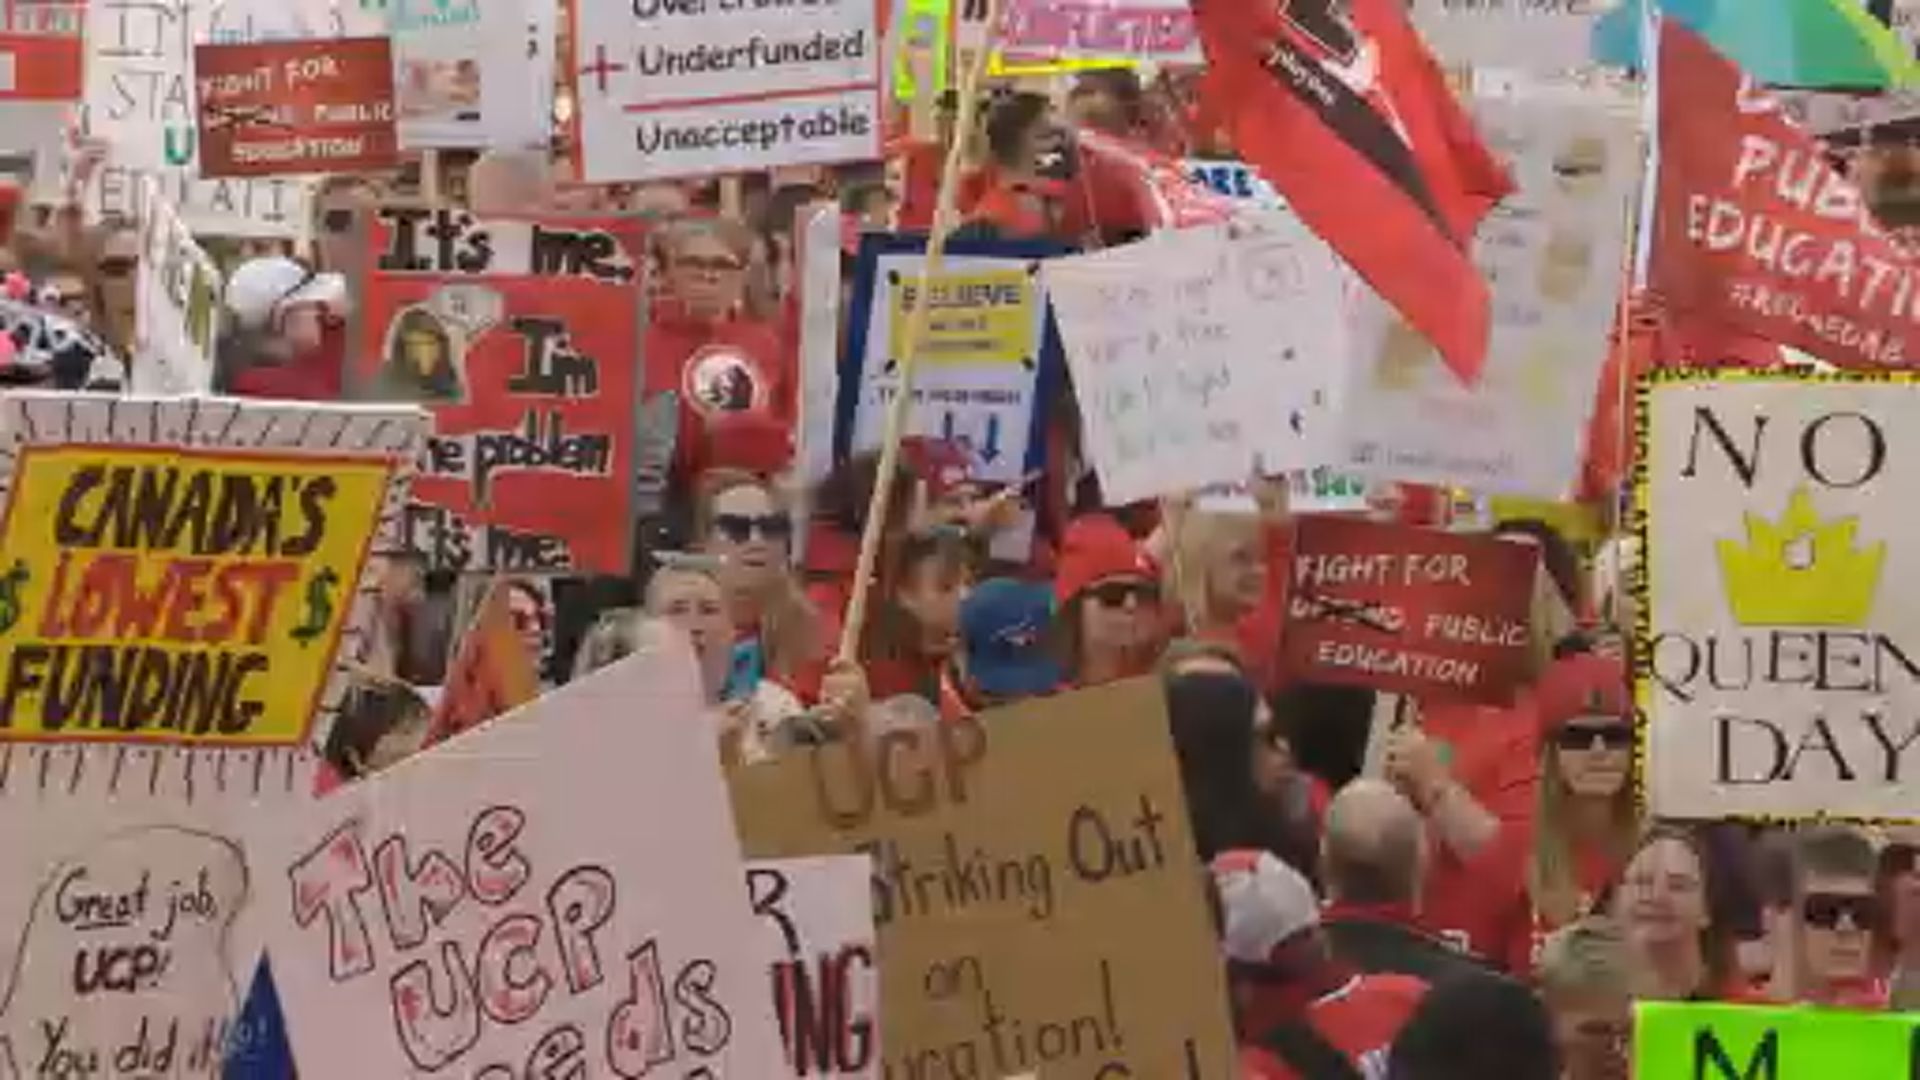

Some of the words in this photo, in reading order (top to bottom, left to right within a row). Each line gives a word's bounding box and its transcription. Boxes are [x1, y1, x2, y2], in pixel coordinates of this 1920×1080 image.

[638, 29, 865, 76] Underfunded
[635, 107, 870, 153] Unacceptable
[376, 208, 494, 275] It's
[507, 317, 600, 394] I'm
[471, 408, 611, 509] problem
[1680, 406, 1887, 489] NO
[54, 464, 339, 556] CANADA'S
[38, 551, 300, 645] LOWEST
[1296, 553, 1396, 587] FIGHT
[1402, 553, 1471, 587] FOR
[1318, 641, 1478, 684] EDUCATION
[1424, 613, 1530, 647] PUBLIC
[0, 643, 269, 735] FUNDING
[1068, 797, 1163, 882] Out
[56, 867, 150, 929] Great
[289, 806, 531, 983] The
[73, 946, 171, 994] UCP!
[390, 865, 617, 1073] UCP
[925, 957, 983, 1000] on
[37, 1016, 98, 1075] You
[115, 1015, 179, 1074] did
